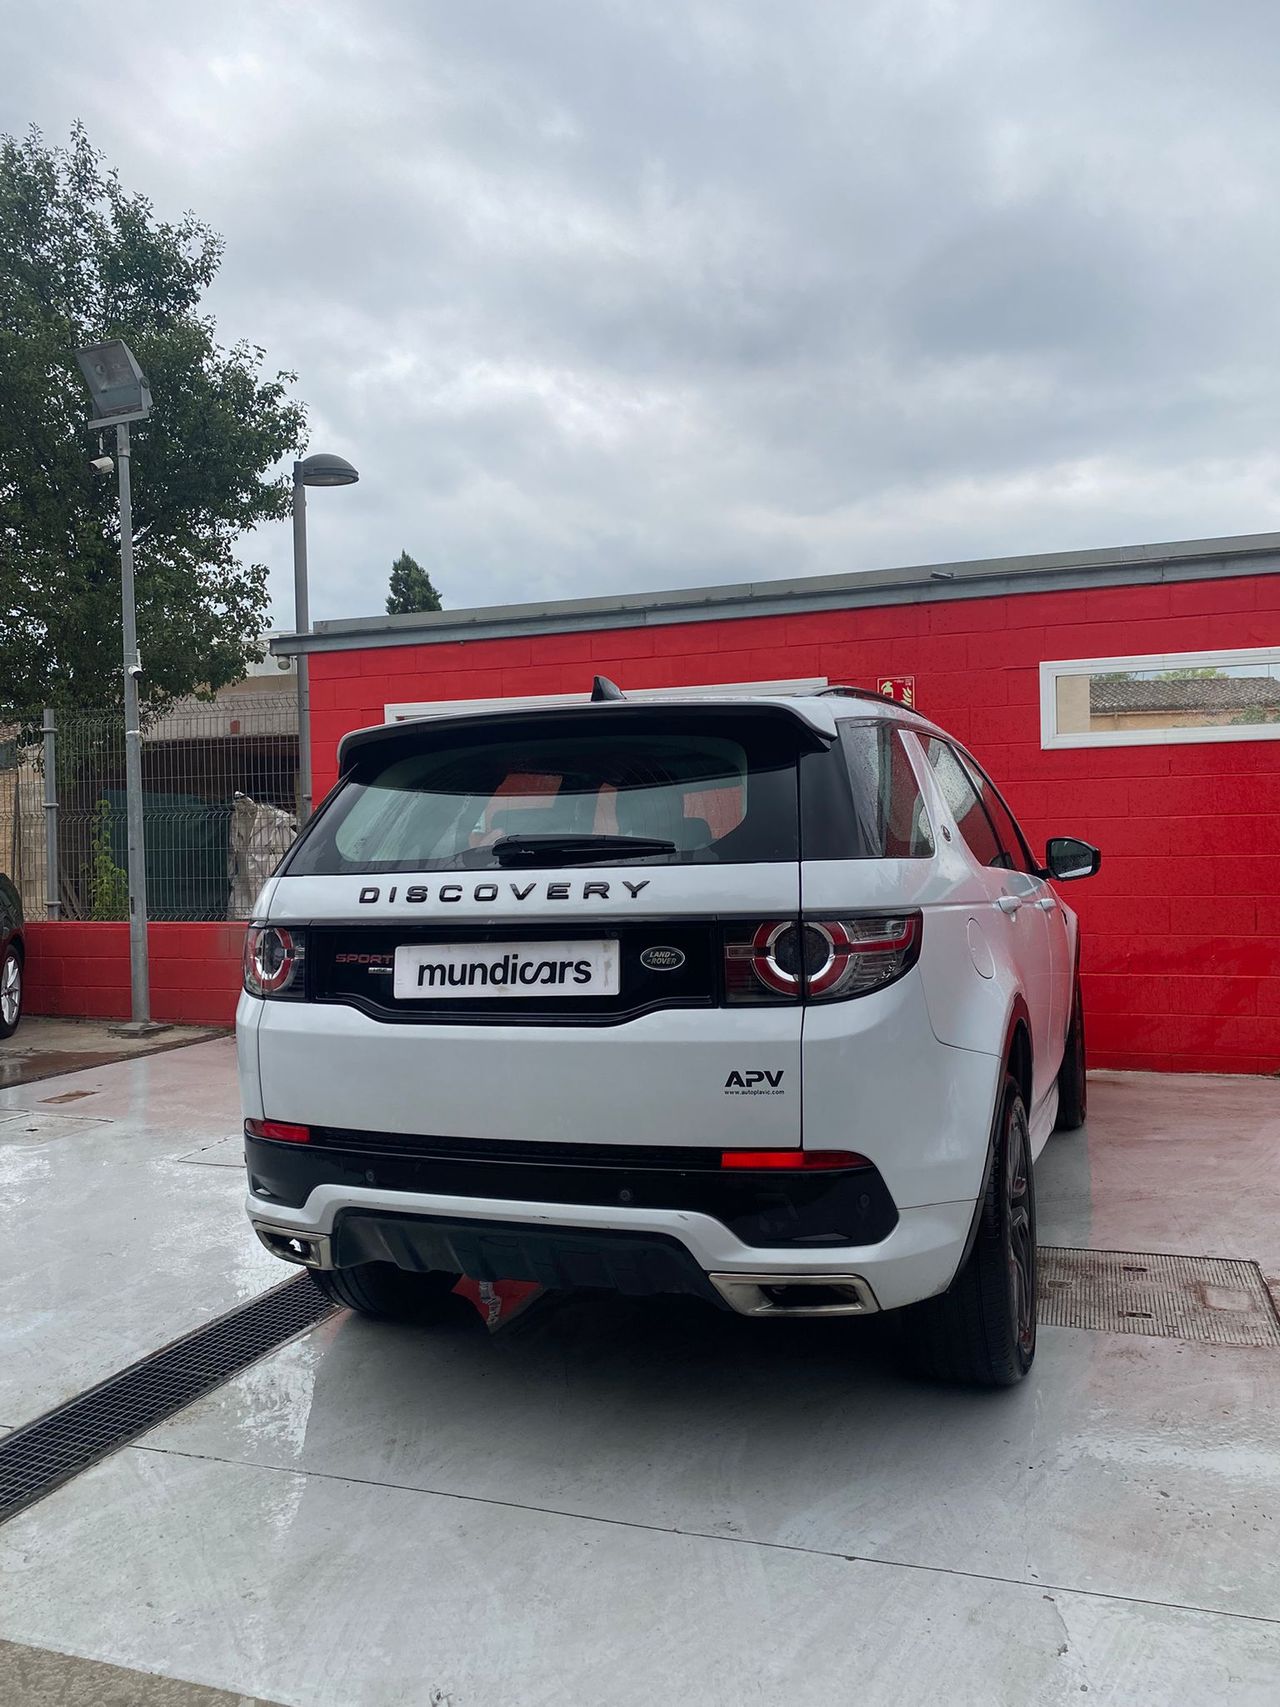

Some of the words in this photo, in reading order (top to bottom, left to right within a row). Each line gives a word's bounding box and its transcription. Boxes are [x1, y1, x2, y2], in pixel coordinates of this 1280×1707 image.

[359, 880, 650, 903] DISCOVERY
[335, 954, 394, 964] SPORT
[417, 954, 592, 986] mundicars
[724, 1070, 784, 1087] APV
